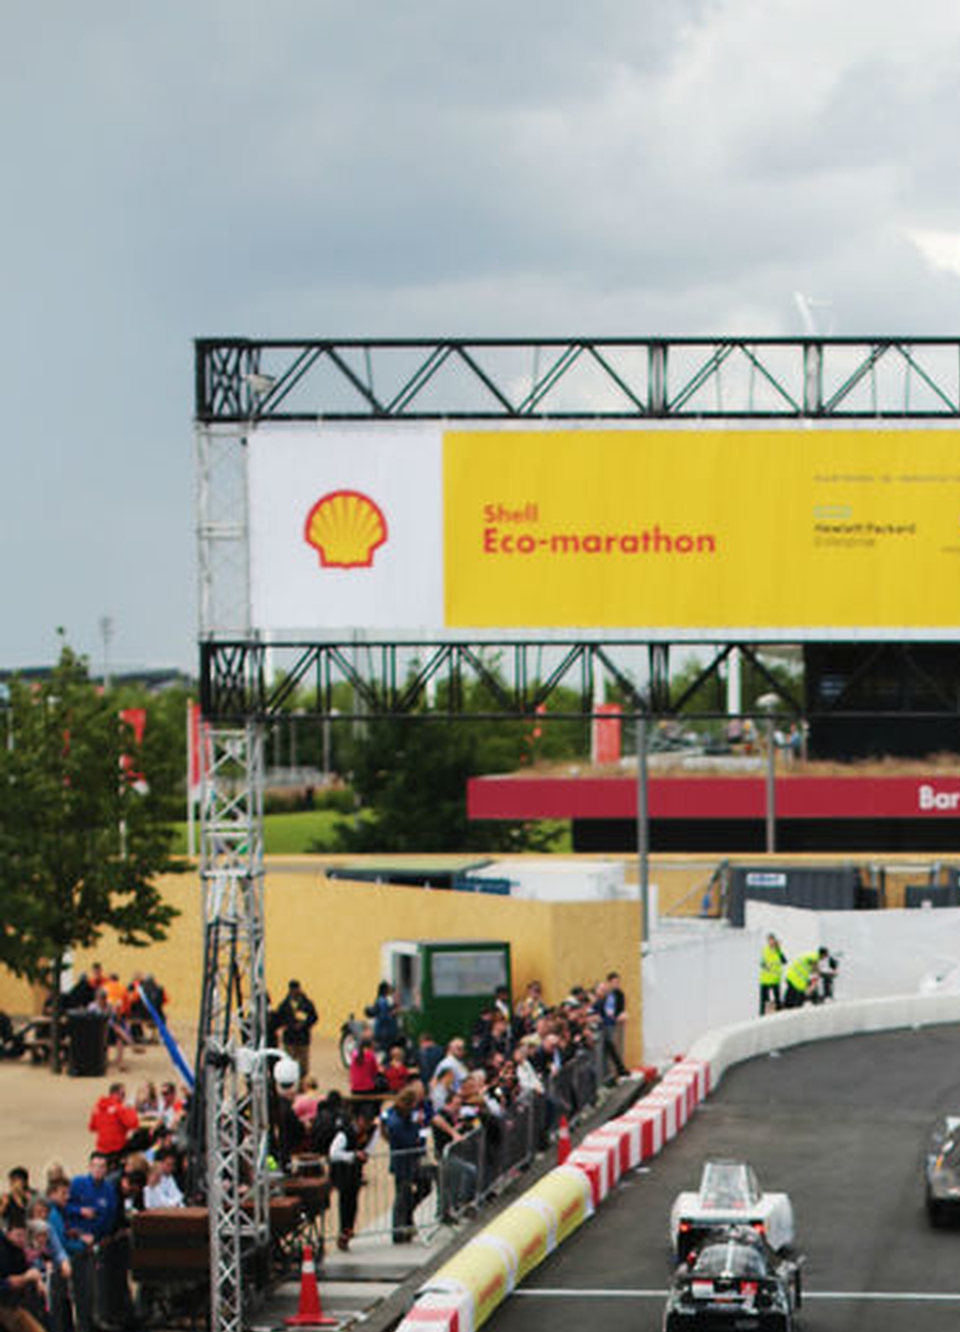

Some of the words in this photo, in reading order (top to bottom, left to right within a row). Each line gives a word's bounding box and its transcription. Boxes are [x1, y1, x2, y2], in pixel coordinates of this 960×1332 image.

[483, 503, 538, 523] Shell
[483, 523, 716, 554] Eco-marathon
[919, 785, 960, 809] Bar
